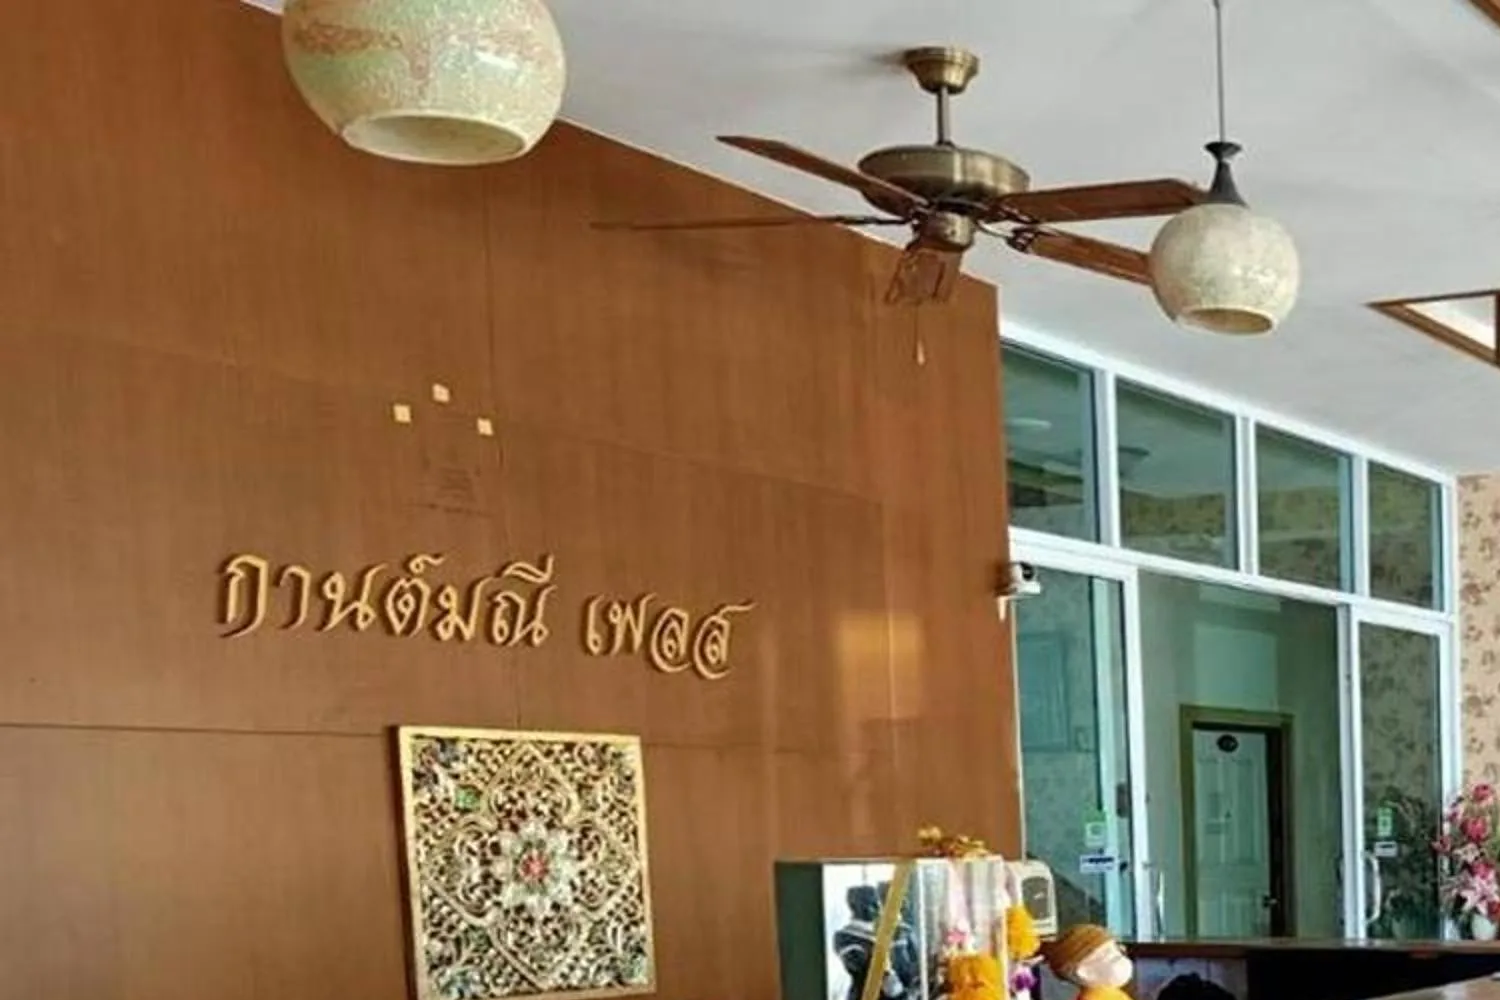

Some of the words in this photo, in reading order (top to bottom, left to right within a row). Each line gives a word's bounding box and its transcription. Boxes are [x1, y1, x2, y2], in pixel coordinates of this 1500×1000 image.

[220, 553, 557, 648] กานต์มณี
[586, 593, 756, 679] เพลส
